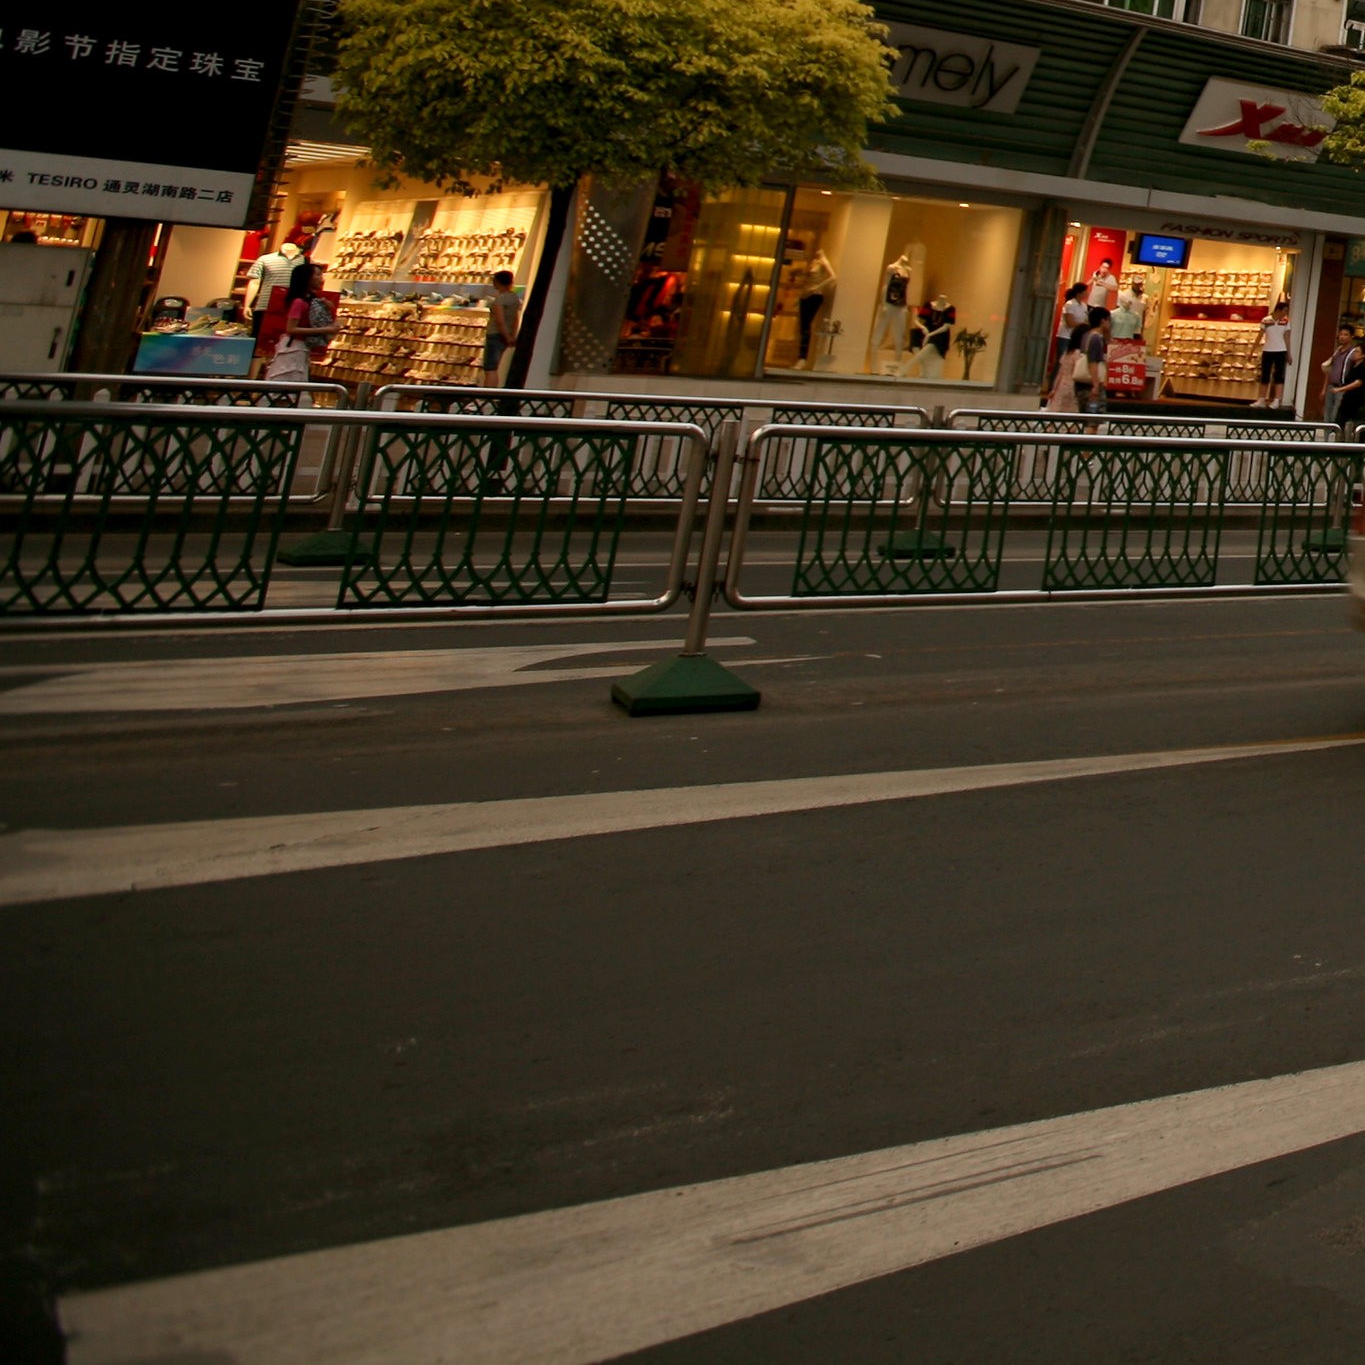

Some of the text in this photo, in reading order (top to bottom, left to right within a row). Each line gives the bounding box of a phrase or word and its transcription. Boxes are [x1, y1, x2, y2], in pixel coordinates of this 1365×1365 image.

[0, 27, 265, 83] 影节指定珠宝
[28, 172, 98, 190] TESIRO
[102, 179, 235, 204] 通灵湖南路二店
